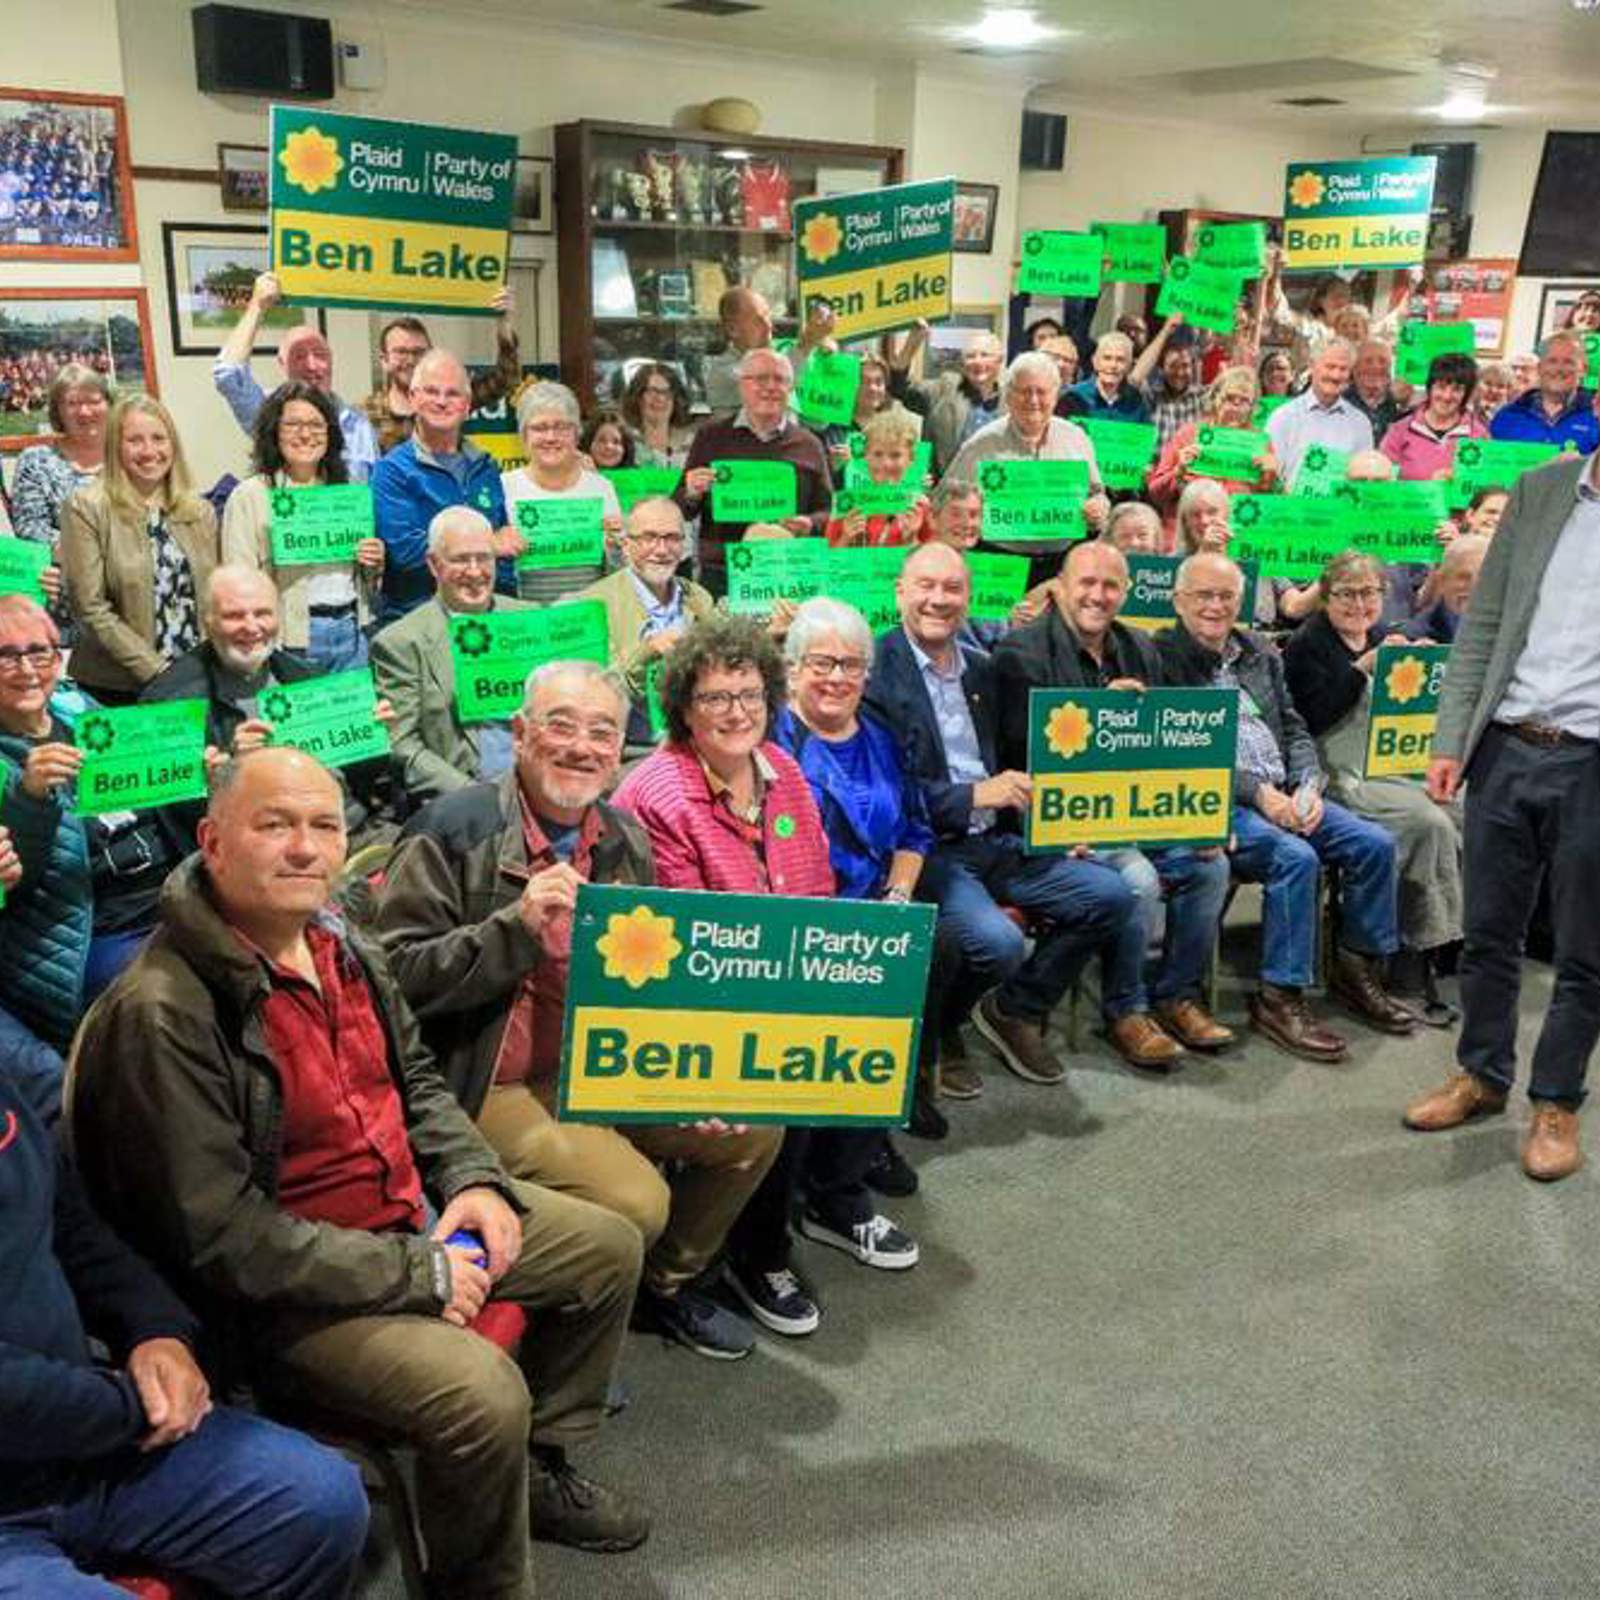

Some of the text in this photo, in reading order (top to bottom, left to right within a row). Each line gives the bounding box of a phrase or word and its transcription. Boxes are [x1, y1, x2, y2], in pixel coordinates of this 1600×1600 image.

[350, 141, 402, 169] Plaid
[434, 153, 512, 181] Party of
[349, 167, 420, 194] Cymru
[432, 175, 495, 202] Wales
[846, 211, 881, 230] Plaid
[899, 221, 941, 239] Wales
[846, 230, 893, 255] Cymru
[1287, 225, 1422, 251] Ben Lake
[280, 228, 501, 282] Ben Lake
[876, 271, 946, 308] Lake
[990, 507, 1073, 524] Ben Lake
[283, 533, 321, 550] Ben
[1386, 529, 1433, 547] Lake
[1239, 543, 1334, 564] Ben Lake
[740, 580, 818, 600] Ben Lake
[1136, 569, 1172, 586] Plaid
[859, 604, 902, 627] ake
[1097, 709, 1138, 728] Plaid
[1163, 708, 1227, 731] Party of
[283, 724, 373, 752] en Lake
[1096, 730, 1151, 752] Cymru
[1161, 731, 1212, 747] Wales
[94, 760, 193, 794] Ben Lake
[1040, 783, 1222, 822] Ben Lake
[691, 921, 761, 949] Plaid
[804, 927, 912, 961] Party of
[687, 950, 782, 984] Cymru
[801, 956, 885, 985] Wales
[584, 1027, 897, 1085] Ben Lake
